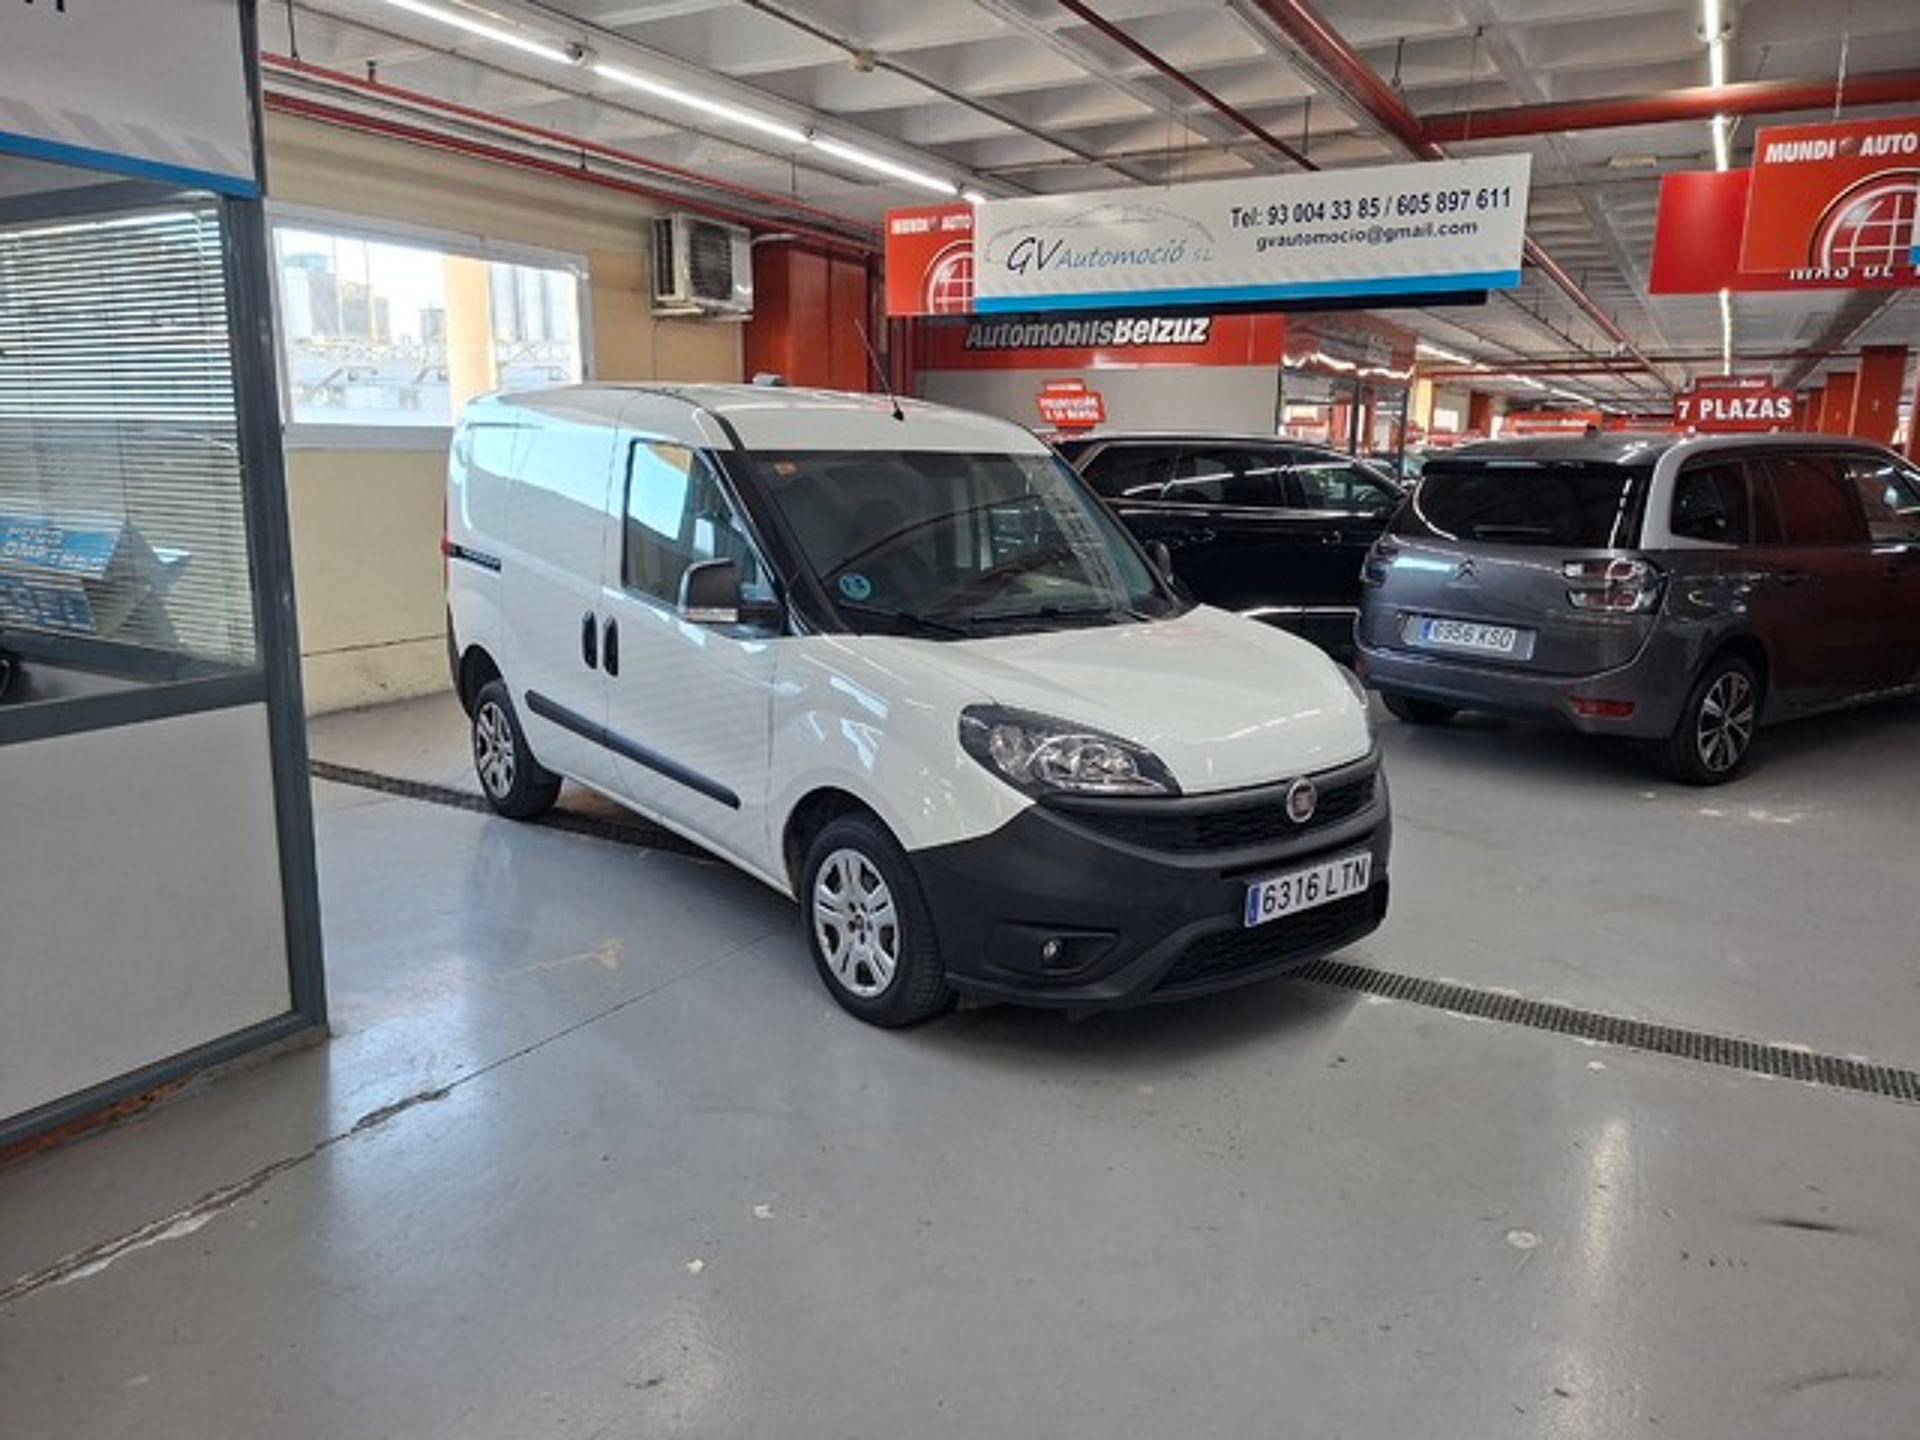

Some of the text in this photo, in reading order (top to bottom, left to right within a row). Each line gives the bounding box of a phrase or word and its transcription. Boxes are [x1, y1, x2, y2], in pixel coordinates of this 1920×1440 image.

[1764, 132, 1918, 163] MUNDI AUTO
[1231, 206, 1263, 228] Tel:
[1267, 205, 1288, 227] 93
[1293, 202, 1325, 224] 004
[1331, 200, 1351, 220] 33
[1357, 197, 1380, 219] 85
[1396, 193, 1432, 216] 605
[1436, 190, 1471, 213] 897
[1476, 186, 1511, 211] 611
[1256, 221, 1477, 251] gvautomocio@gmail.com
[1677, 396, 1792, 420] 7 PLAZAS
[1263, 859, 1368, 915] 6316 LTN
